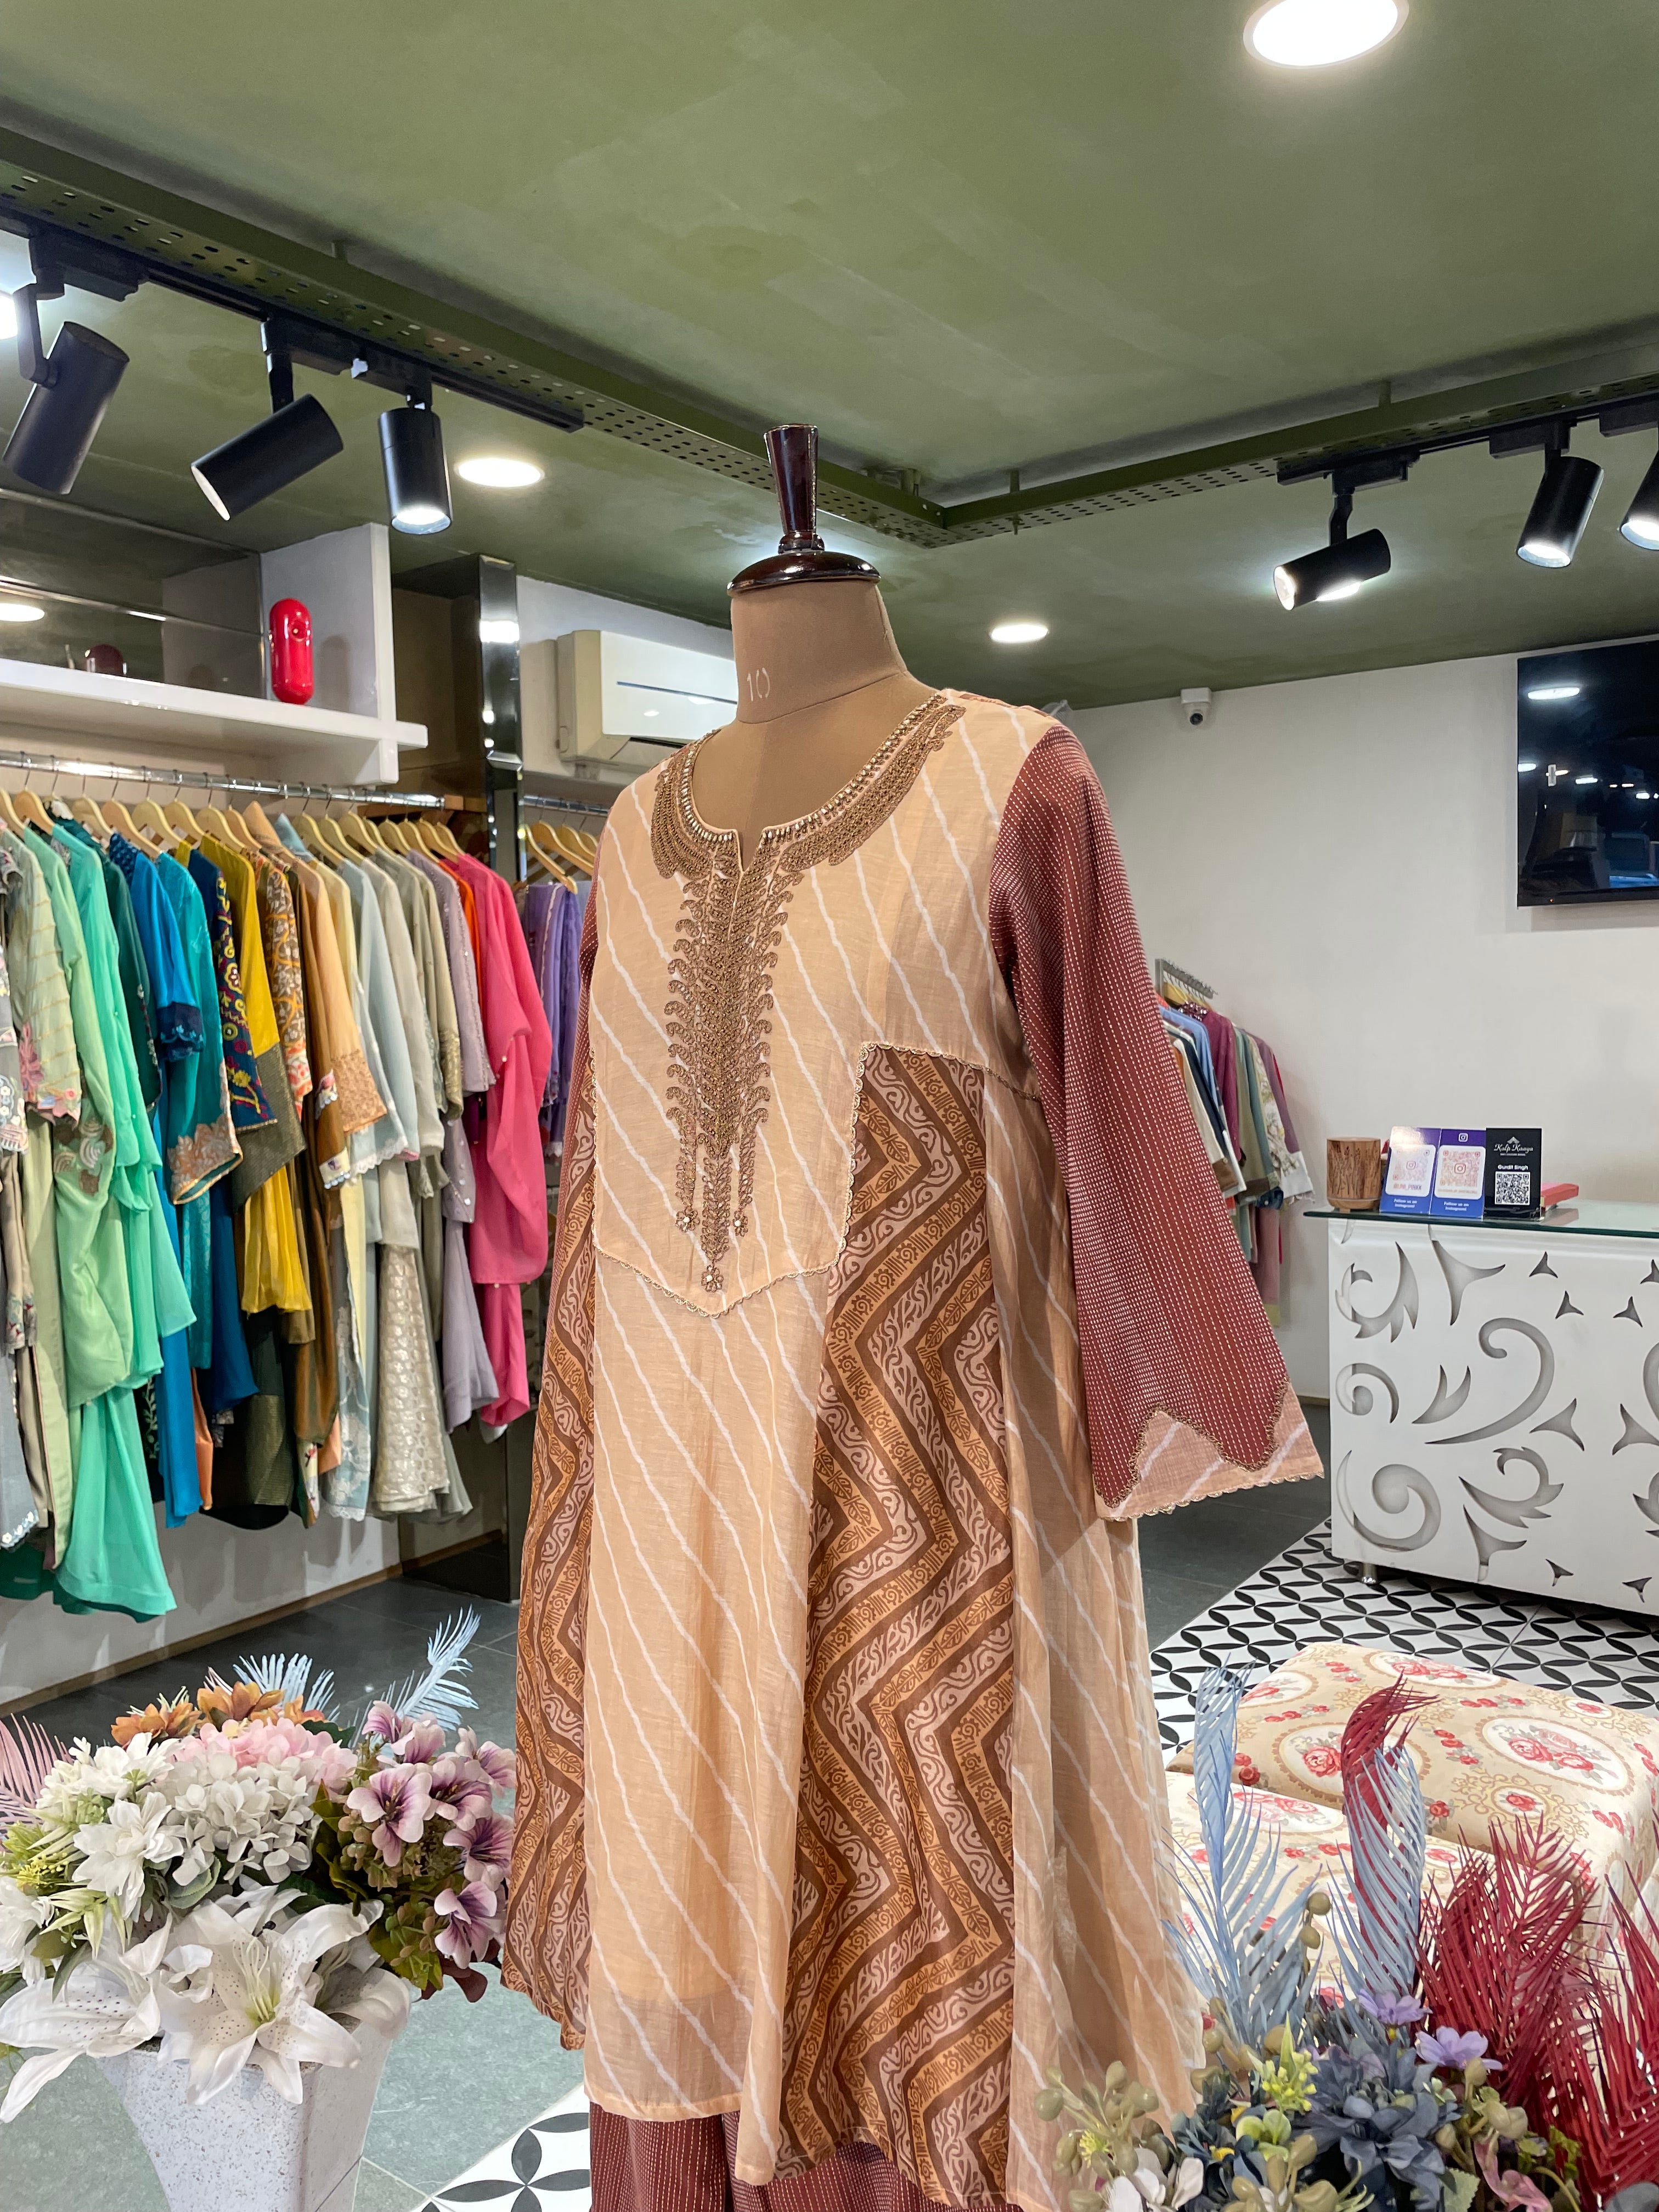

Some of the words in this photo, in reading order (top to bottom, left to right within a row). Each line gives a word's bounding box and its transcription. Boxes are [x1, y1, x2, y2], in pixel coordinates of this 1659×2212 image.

[747, 668, 770, 702] 10
[1493, 1144, 1510, 1153] Kalp
[1511, 1144, 1533, 1154] Kaaya
